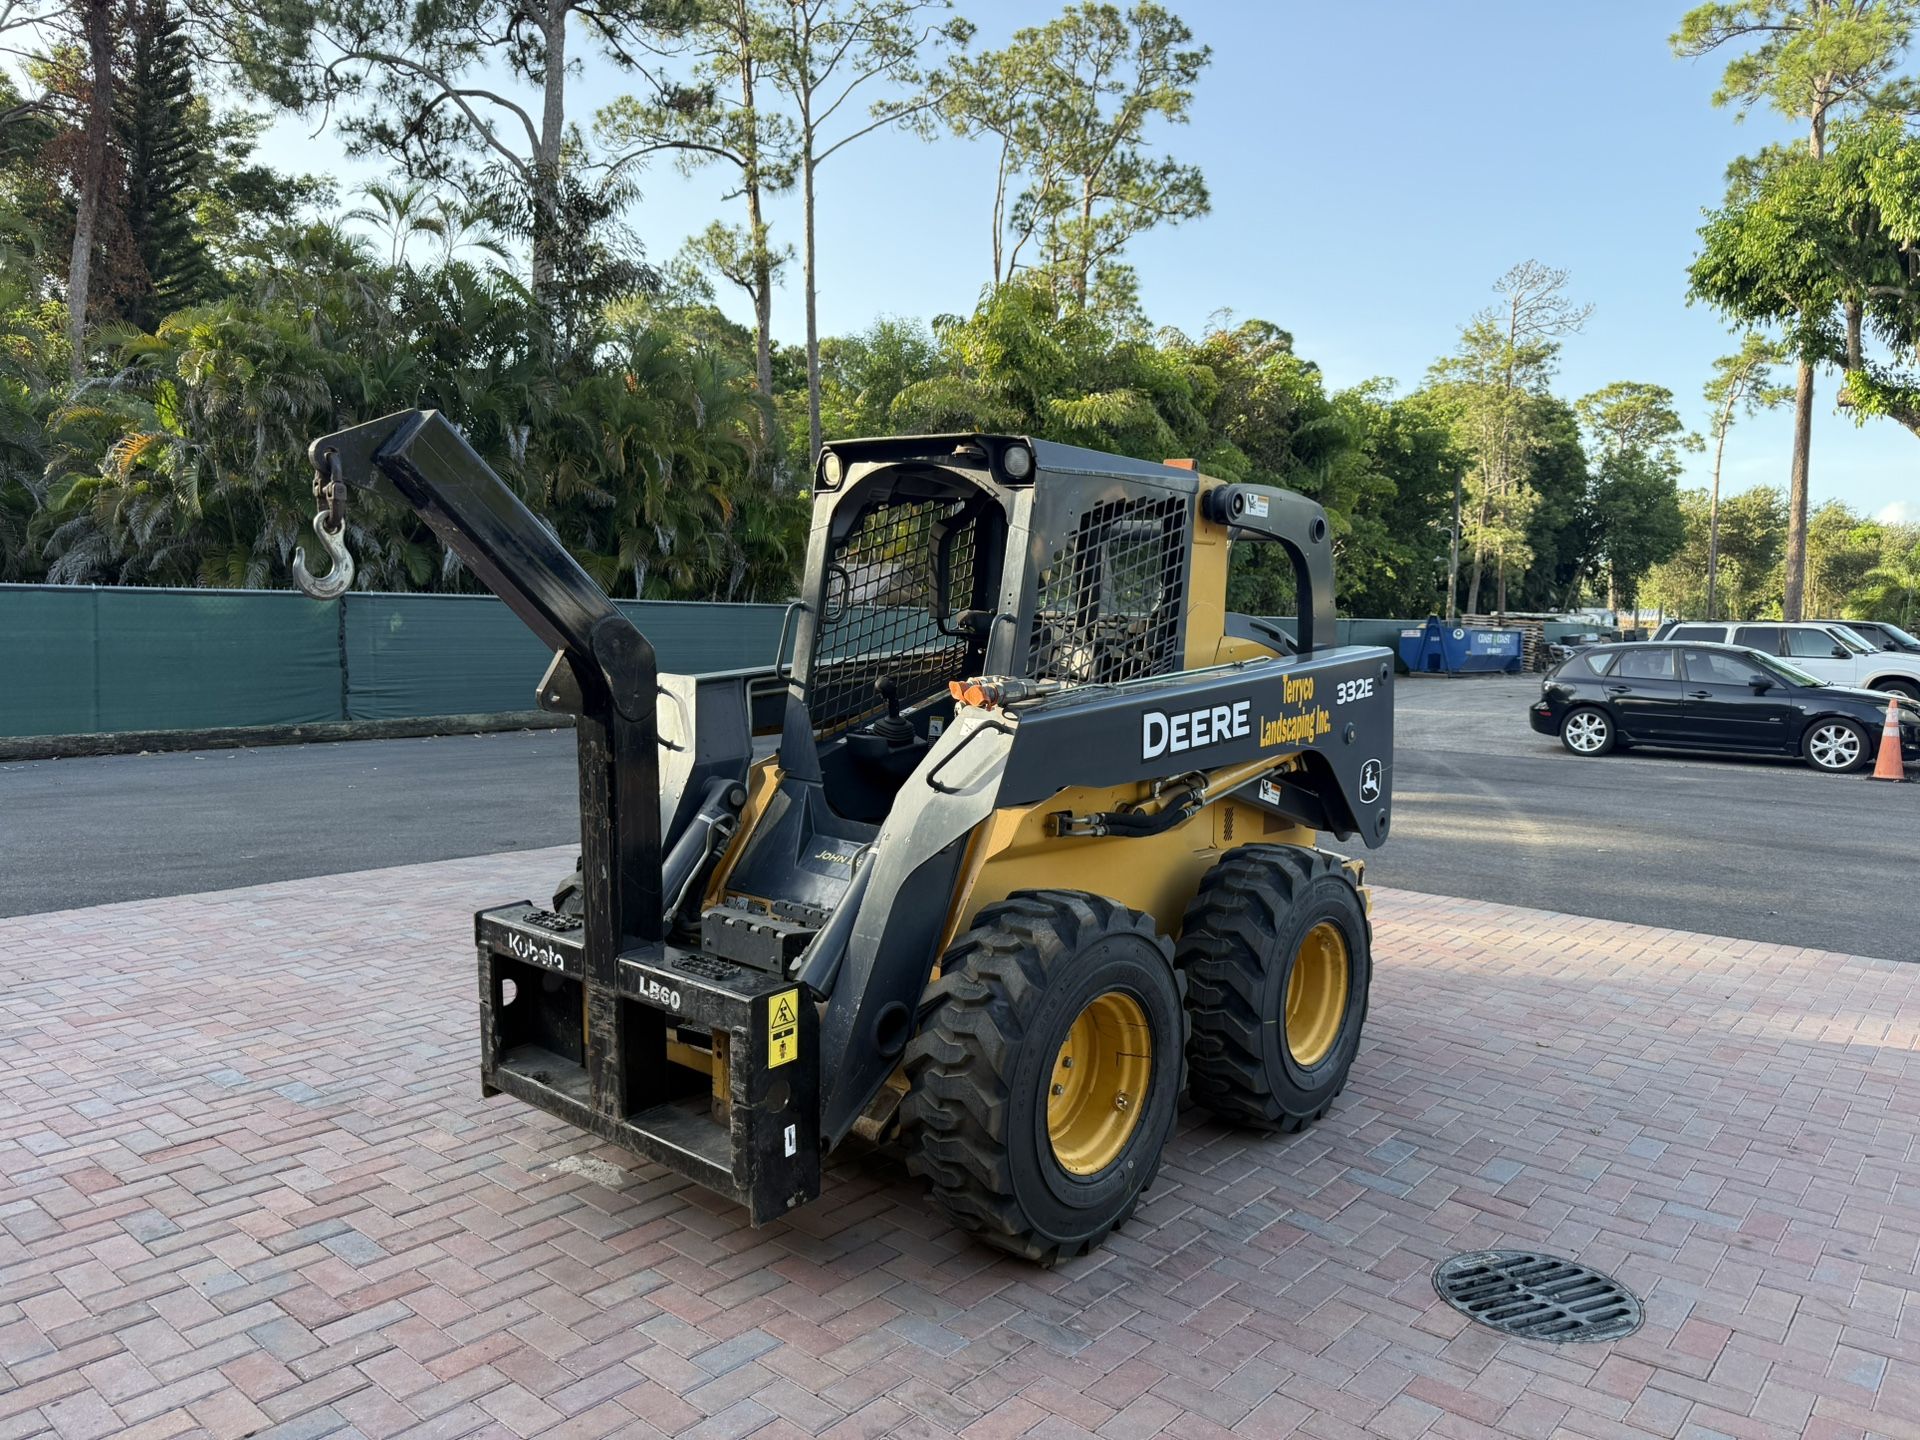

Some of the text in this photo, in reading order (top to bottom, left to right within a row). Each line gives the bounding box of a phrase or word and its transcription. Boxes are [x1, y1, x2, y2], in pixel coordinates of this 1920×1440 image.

[1282, 674, 1314, 708] Terryco
[1336, 678, 1374, 705] 332E
[1142, 700, 1250, 760] DEERE
[1260, 704, 1331, 748] Landscaping Inc.
[814, 850, 848, 865] JOHN
[508, 932, 565, 972] Kubota
[639, 975, 681, 1010] LB60
